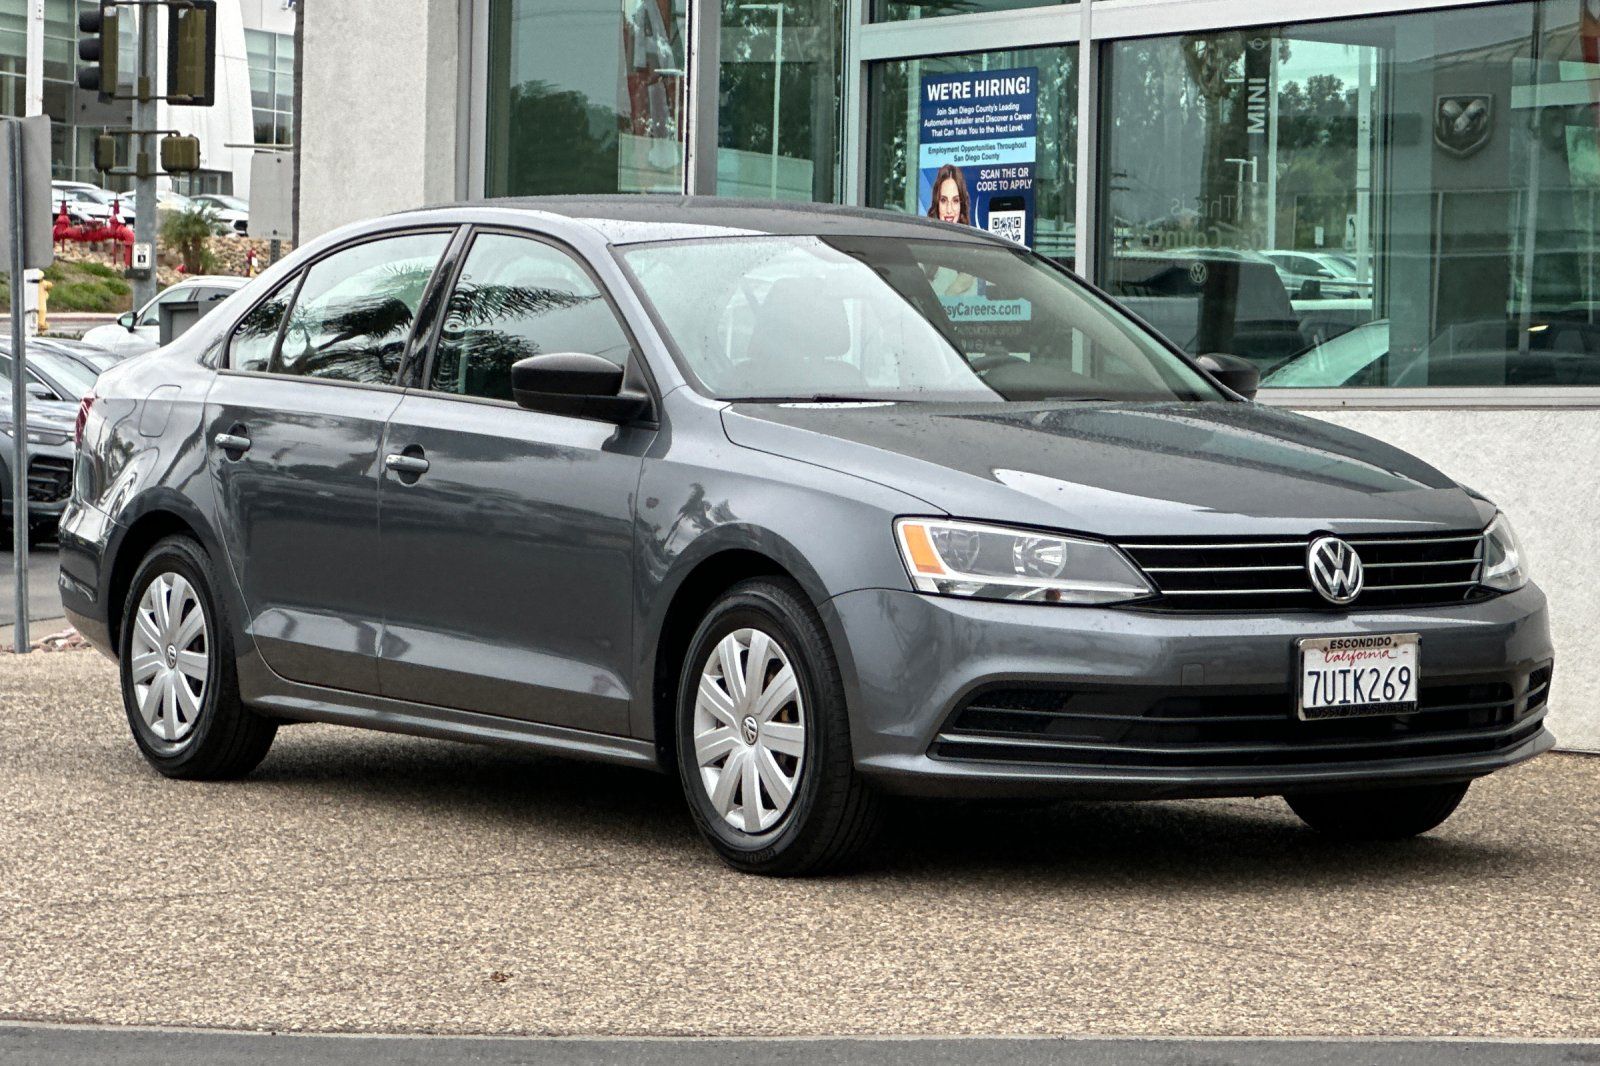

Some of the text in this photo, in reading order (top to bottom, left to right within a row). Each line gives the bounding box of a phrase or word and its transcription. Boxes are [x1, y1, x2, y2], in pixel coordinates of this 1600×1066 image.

[927, 76, 1030, 101] WE'RE HIRING!
[936, 102, 1020, 116] Join San Diego County's Leading
[1247, 78, 1266, 133] MINI
[924, 118, 953, 127] Automotive
[954, 116, 974, 125] Retailer
[985, 114, 1008, 123] Discover
[1013, 112, 1032, 121] Career
[932, 123, 1024, 137] That Can Take You to the Next Level.
[928, 141, 1027, 155] Employment Opportunities Throughout
[953, 152, 1000, 162] San Diego County
[980, 167, 1029, 179] SCAN THE QR
[976, 179, 1032, 191] CODE TO APPLY
[1308, 536, 1363, 604] VW
[1329, 637, 1392, 649] ESCONDIDO
[1324, 649, 1397, 667] California
[1307, 666, 1411, 705] 7UIK269
